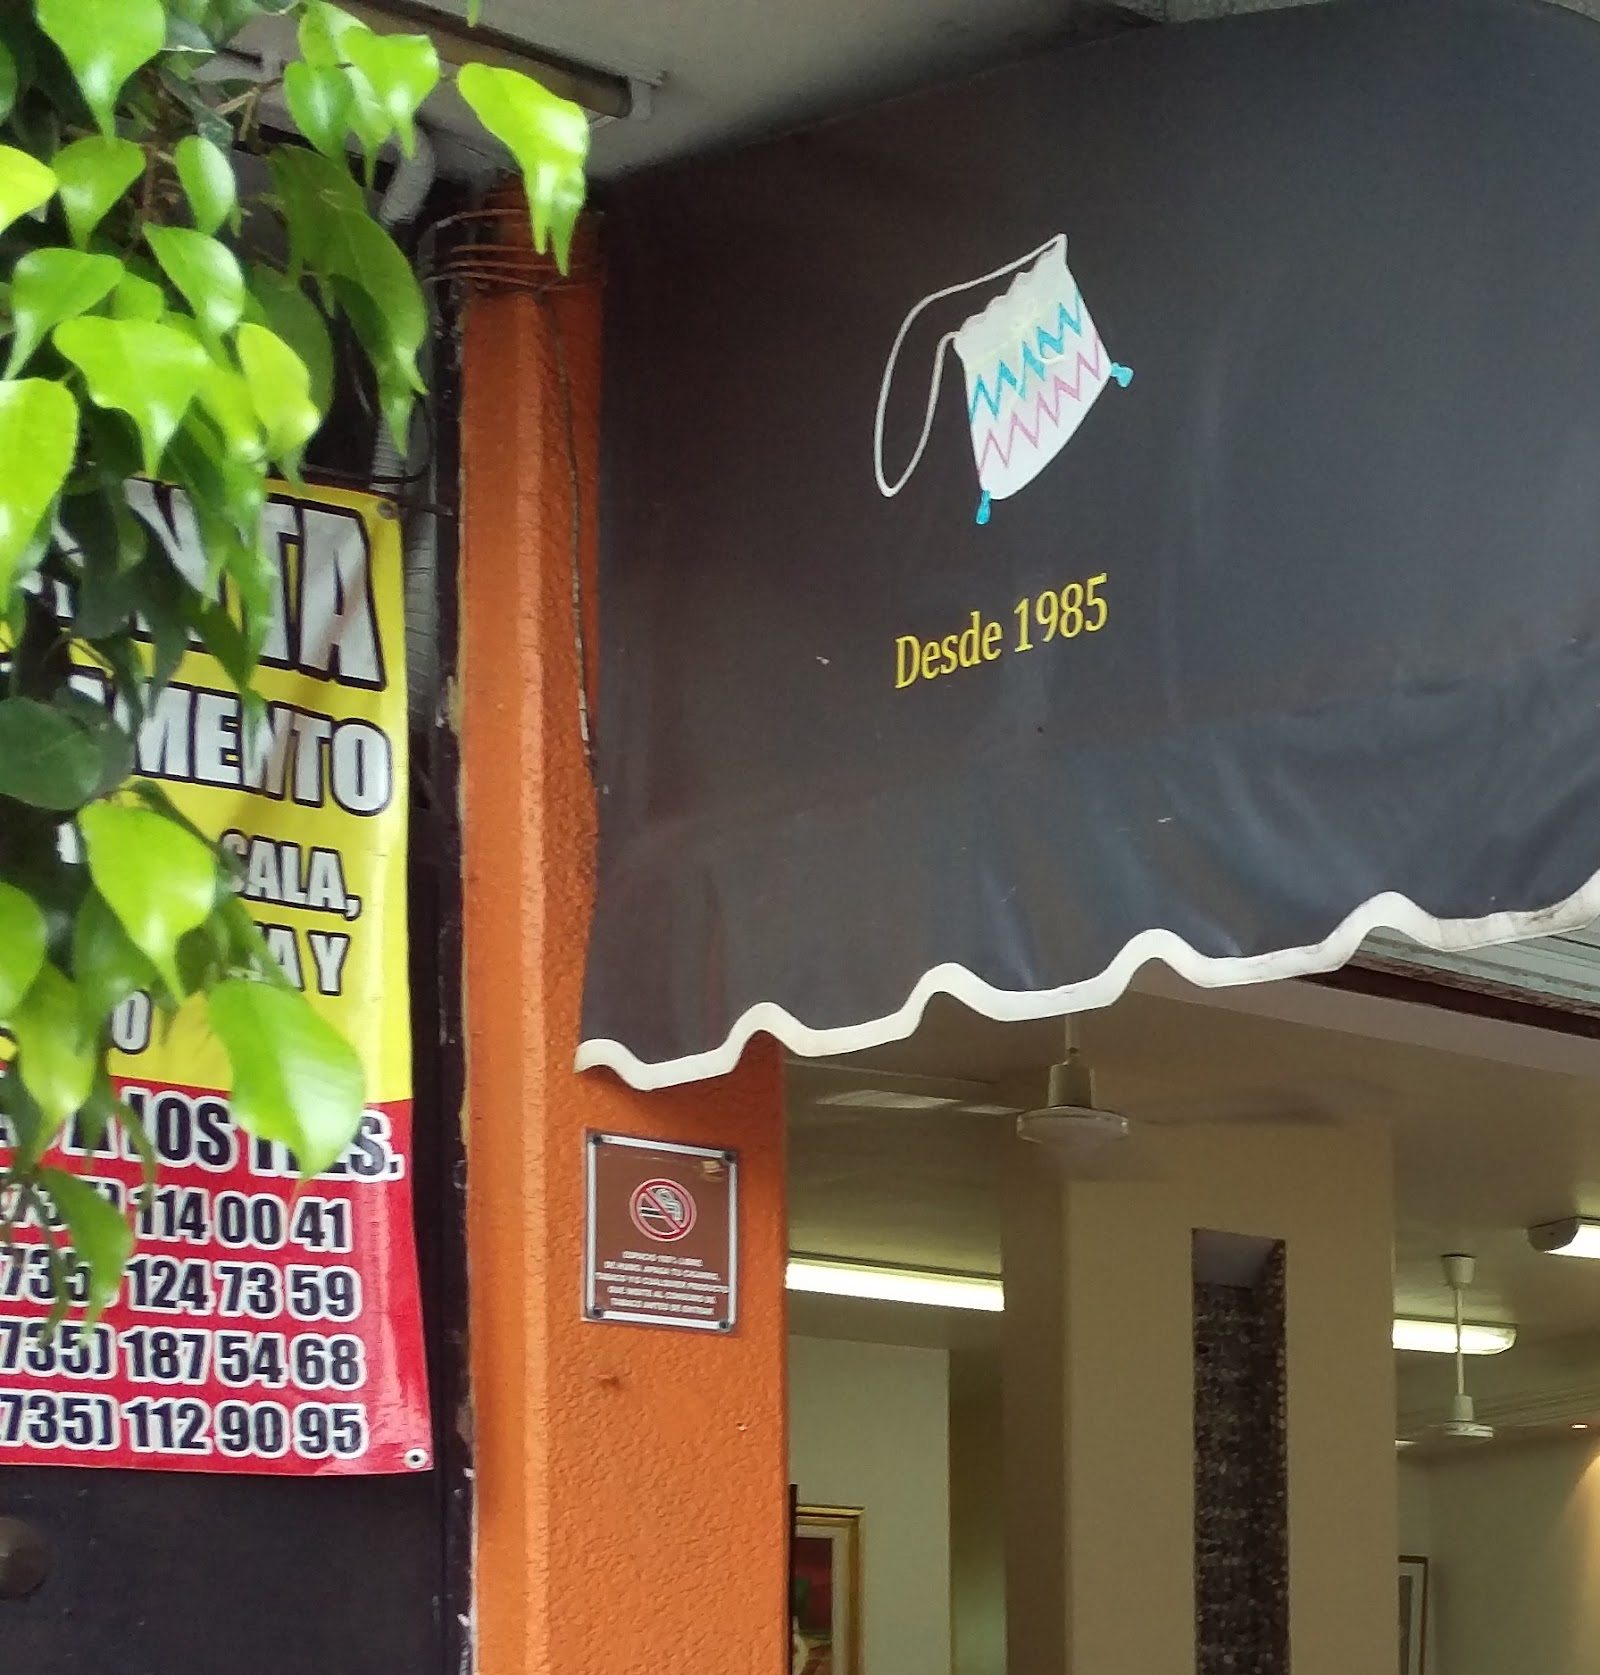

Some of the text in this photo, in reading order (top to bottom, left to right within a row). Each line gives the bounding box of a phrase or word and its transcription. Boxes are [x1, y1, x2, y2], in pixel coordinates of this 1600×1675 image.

[895, 572, 1110, 689] Desde 1985
[132, 1186, 208, 1239] 114
[217, 1194, 283, 1246] 00
[293, 1197, 350, 1250] 41
[126, 1258, 210, 1311] 124
[218, 1264, 277, 1316] 73
[290, 1267, 357, 1318] 59
[123, 1329, 208, 1380] 187
[219, 1334, 284, 1386] 54
[294, 1337, 360, 1388] 68
[125, 1399, 209, 1451] 112
[219, 1403, 284, 1456] 90
[294, 1404, 364, 1456] 95
